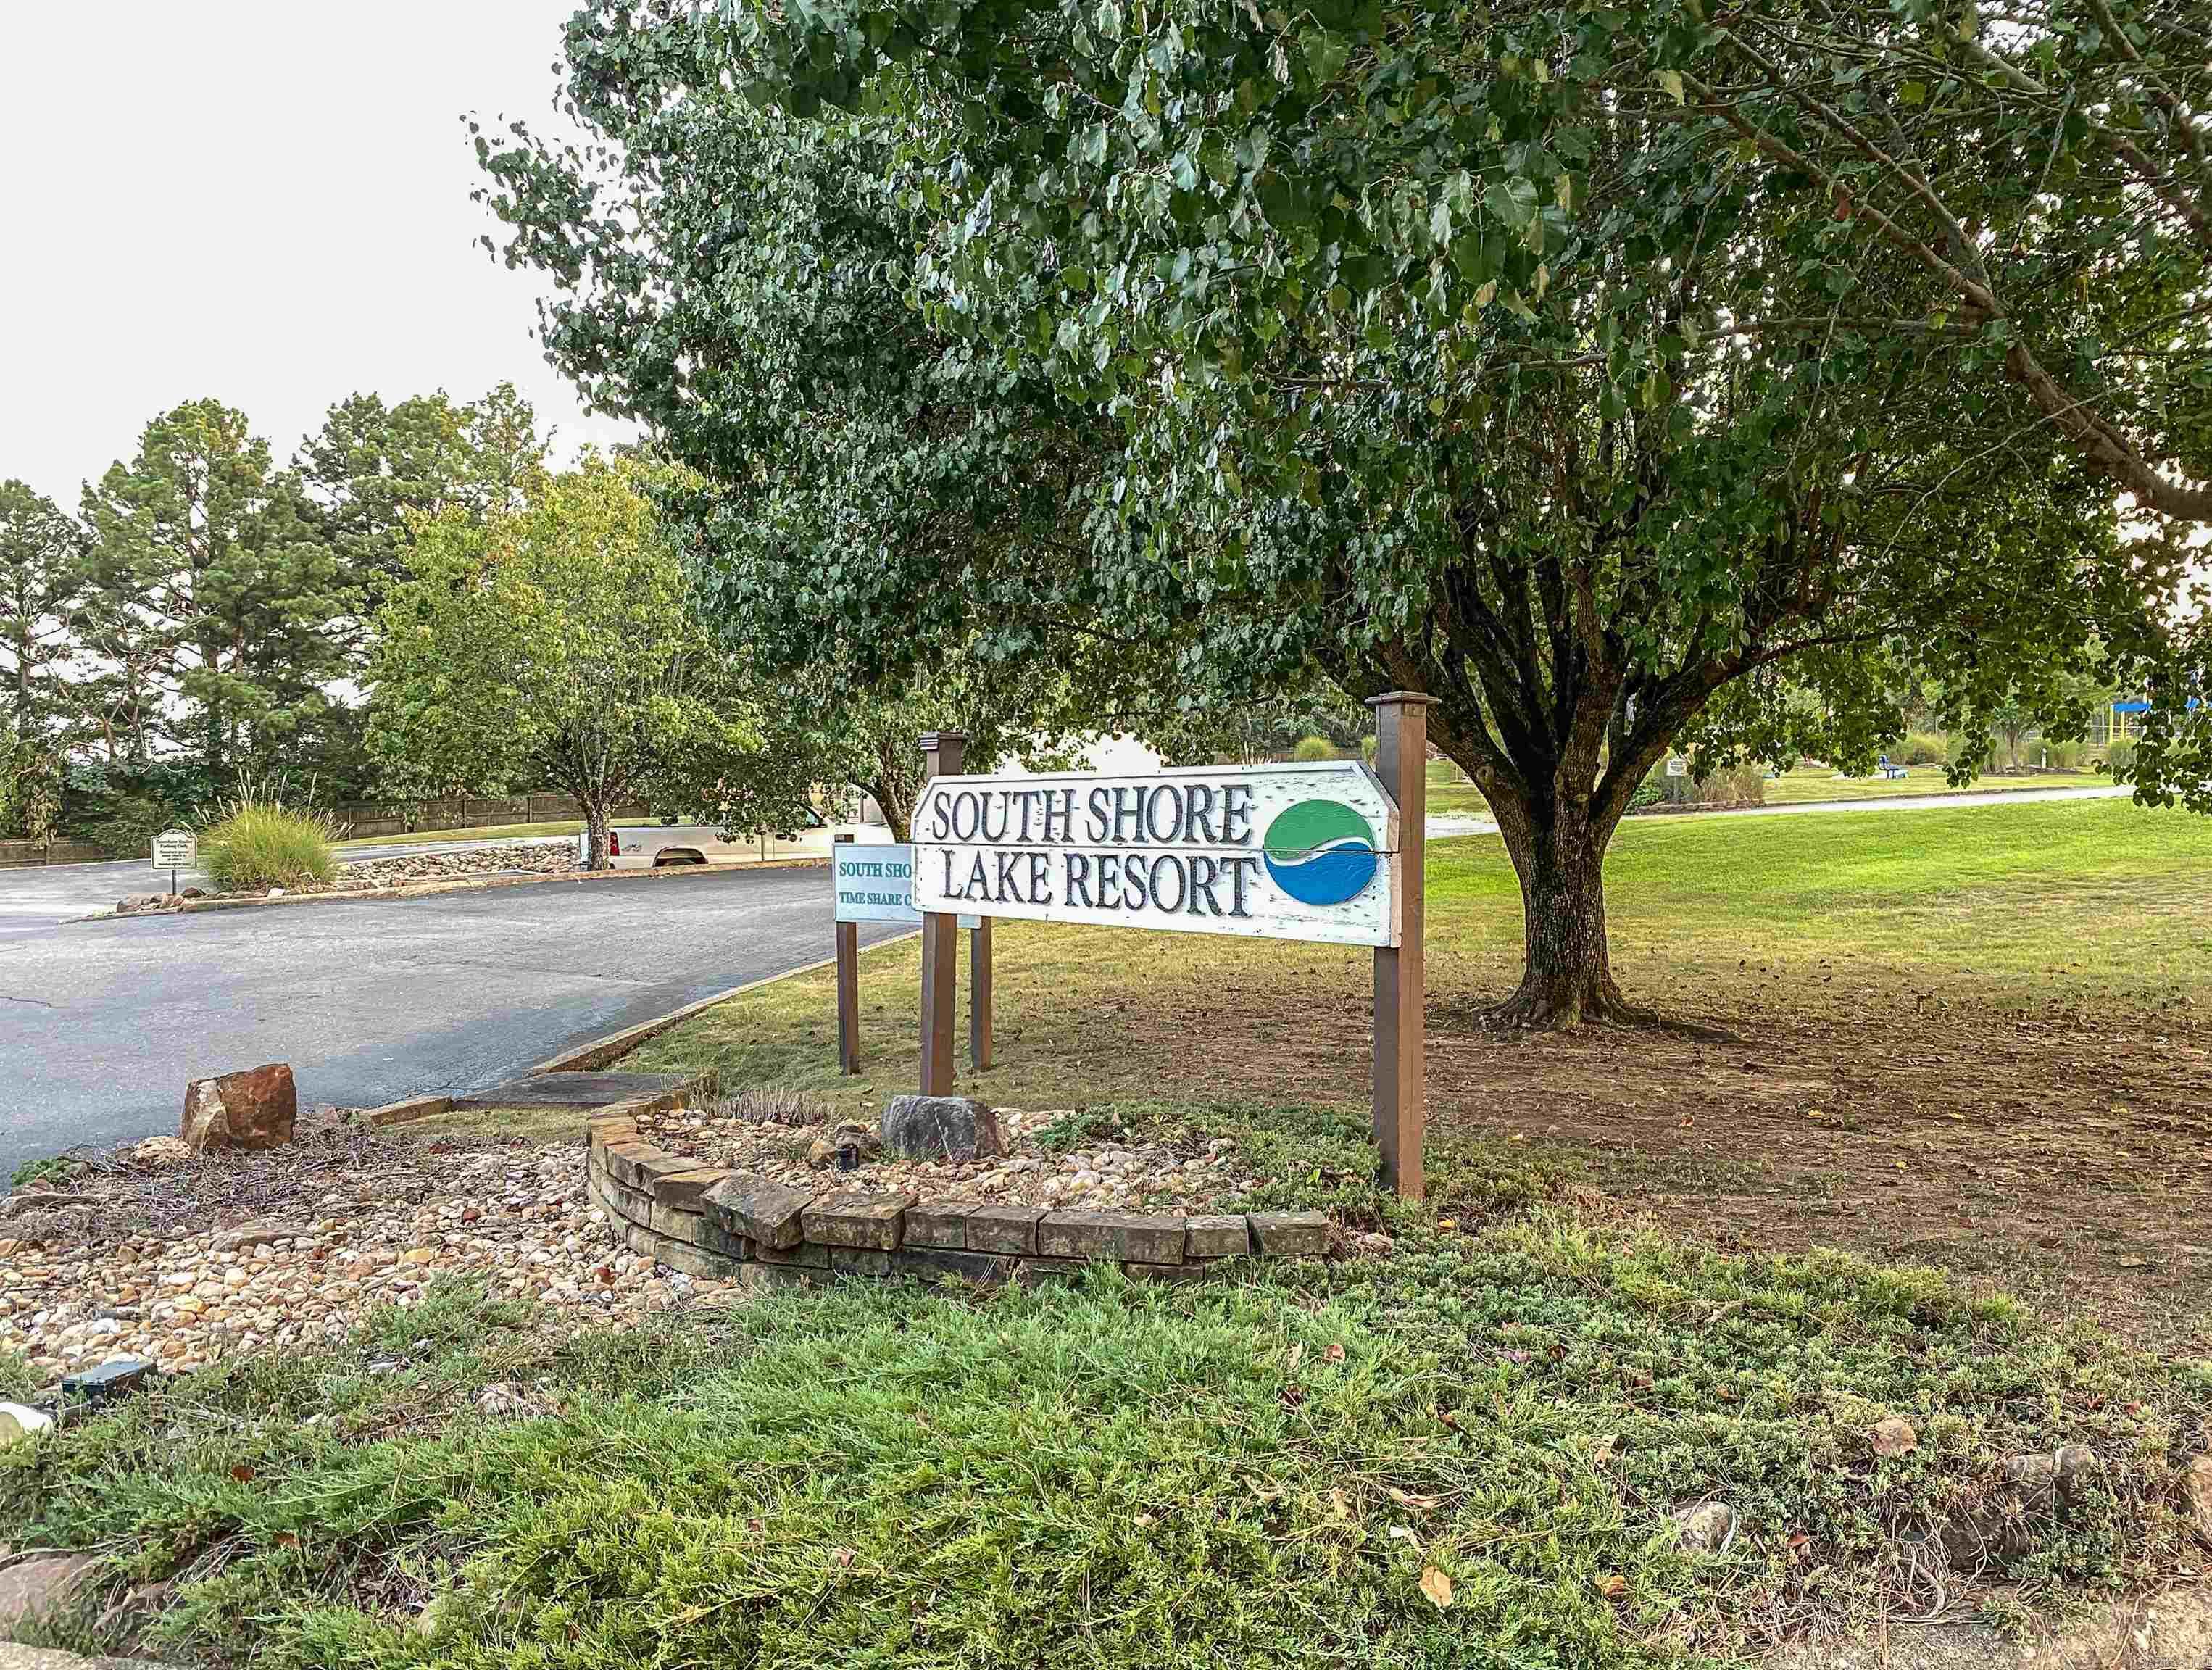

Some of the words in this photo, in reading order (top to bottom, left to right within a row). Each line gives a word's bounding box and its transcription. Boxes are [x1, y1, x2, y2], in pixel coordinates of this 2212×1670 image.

[932, 789, 1076, 843] SOUTH
[1085, 784, 1253, 845] SHORE
[839, 862, 883, 877] SOUTH
[885, 863, 912, 878] SHO
[941, 849, 1053, 905] LAKE
[1063, 852, 1259, 918] RESORT
[839, 892, 865, 905] TIME
[867, 892, 902, 905] SHARE
